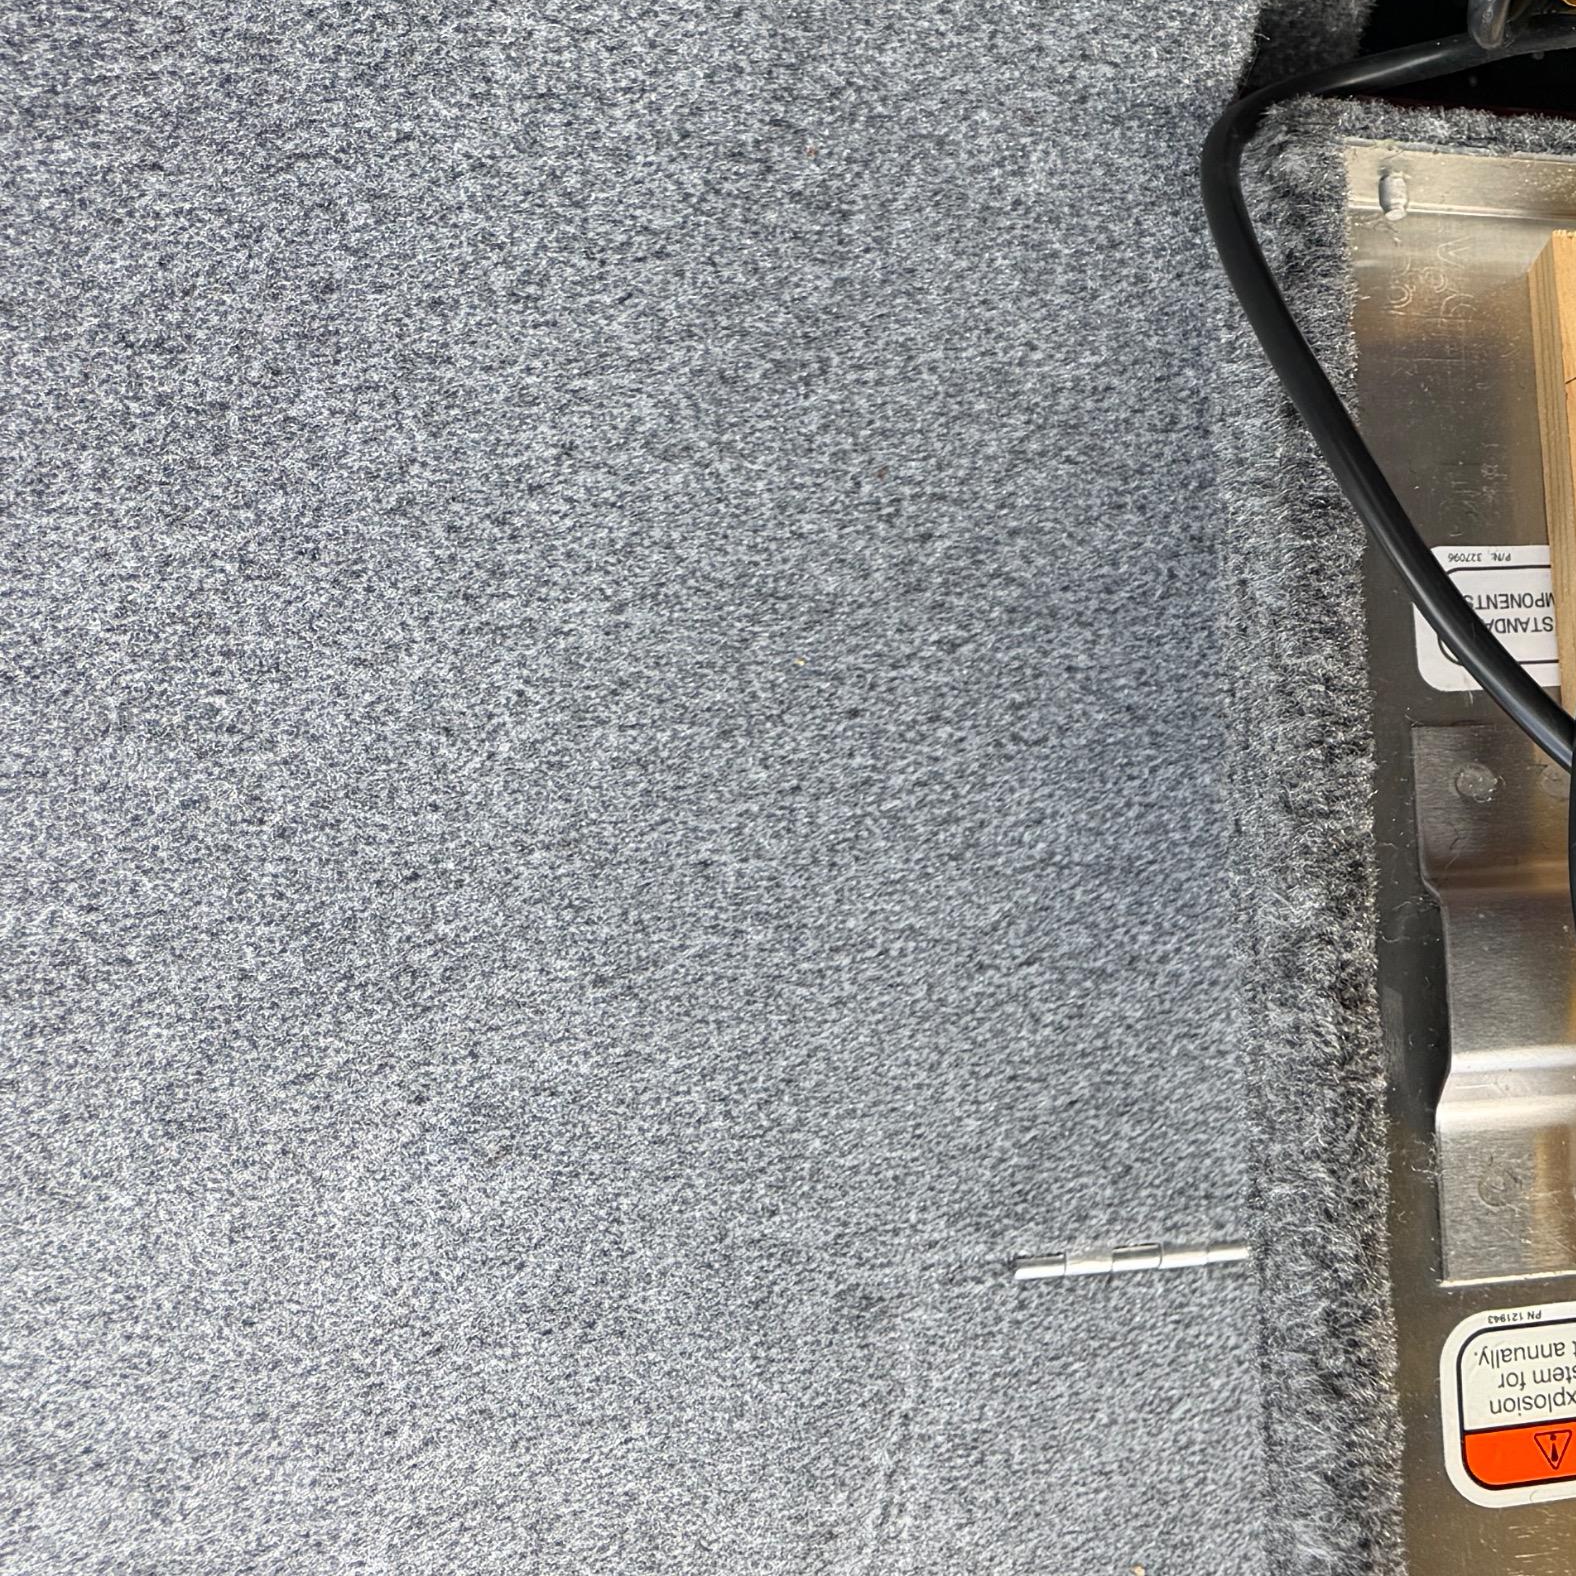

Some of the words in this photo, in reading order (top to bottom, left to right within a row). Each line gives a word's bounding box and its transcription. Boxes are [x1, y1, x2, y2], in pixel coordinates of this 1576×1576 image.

[1448, 552, 1483, 563] 327096
[1481, 616, 1553, 635] STANDA
[1474, 1342, 1565, 1369] annually.
[1498, 1371, 1526, 1391] for
